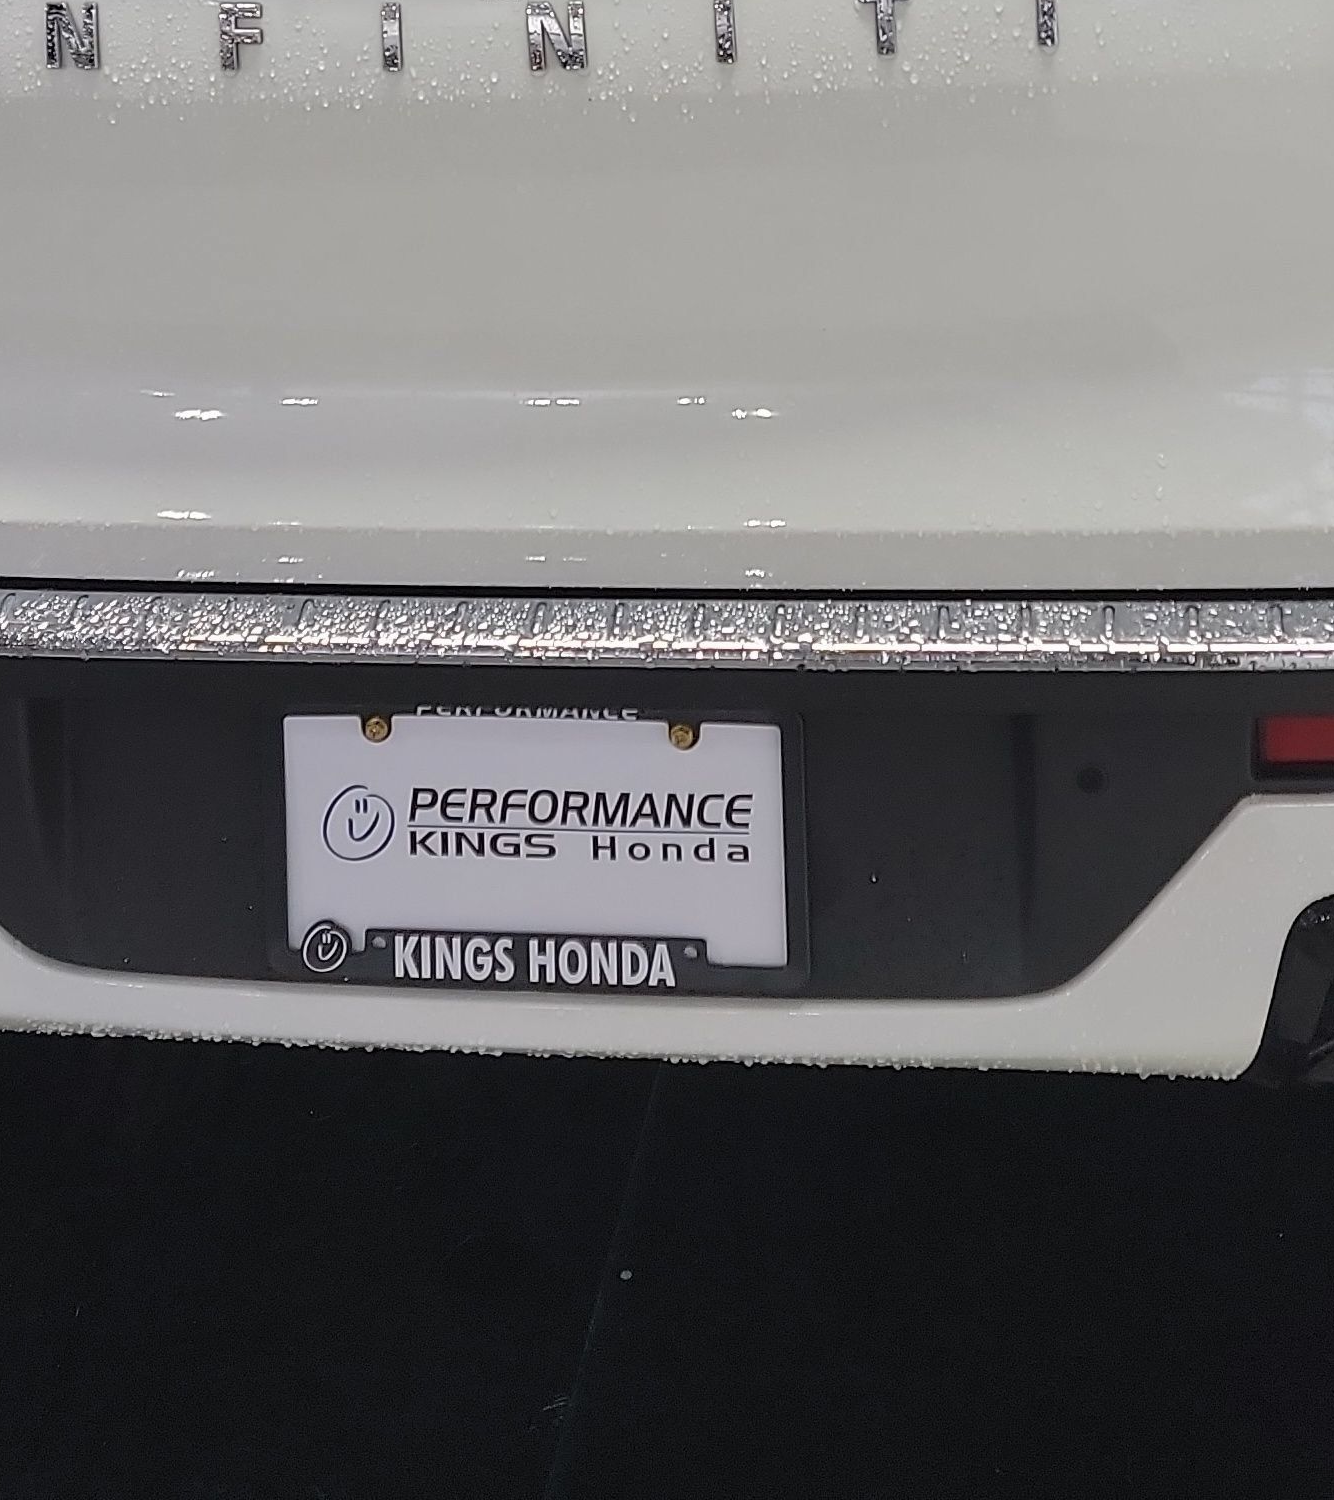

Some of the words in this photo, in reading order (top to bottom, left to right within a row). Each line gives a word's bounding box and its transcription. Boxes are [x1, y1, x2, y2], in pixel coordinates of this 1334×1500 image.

[408, 786, 754, 830] PERFORMANCE
[409, 830, 557, 859] KINGS
[591, 835, 750, 863] Honda
[394, 933, 515, 982] KINGS
[528, 937, 676, 987] HONDA
